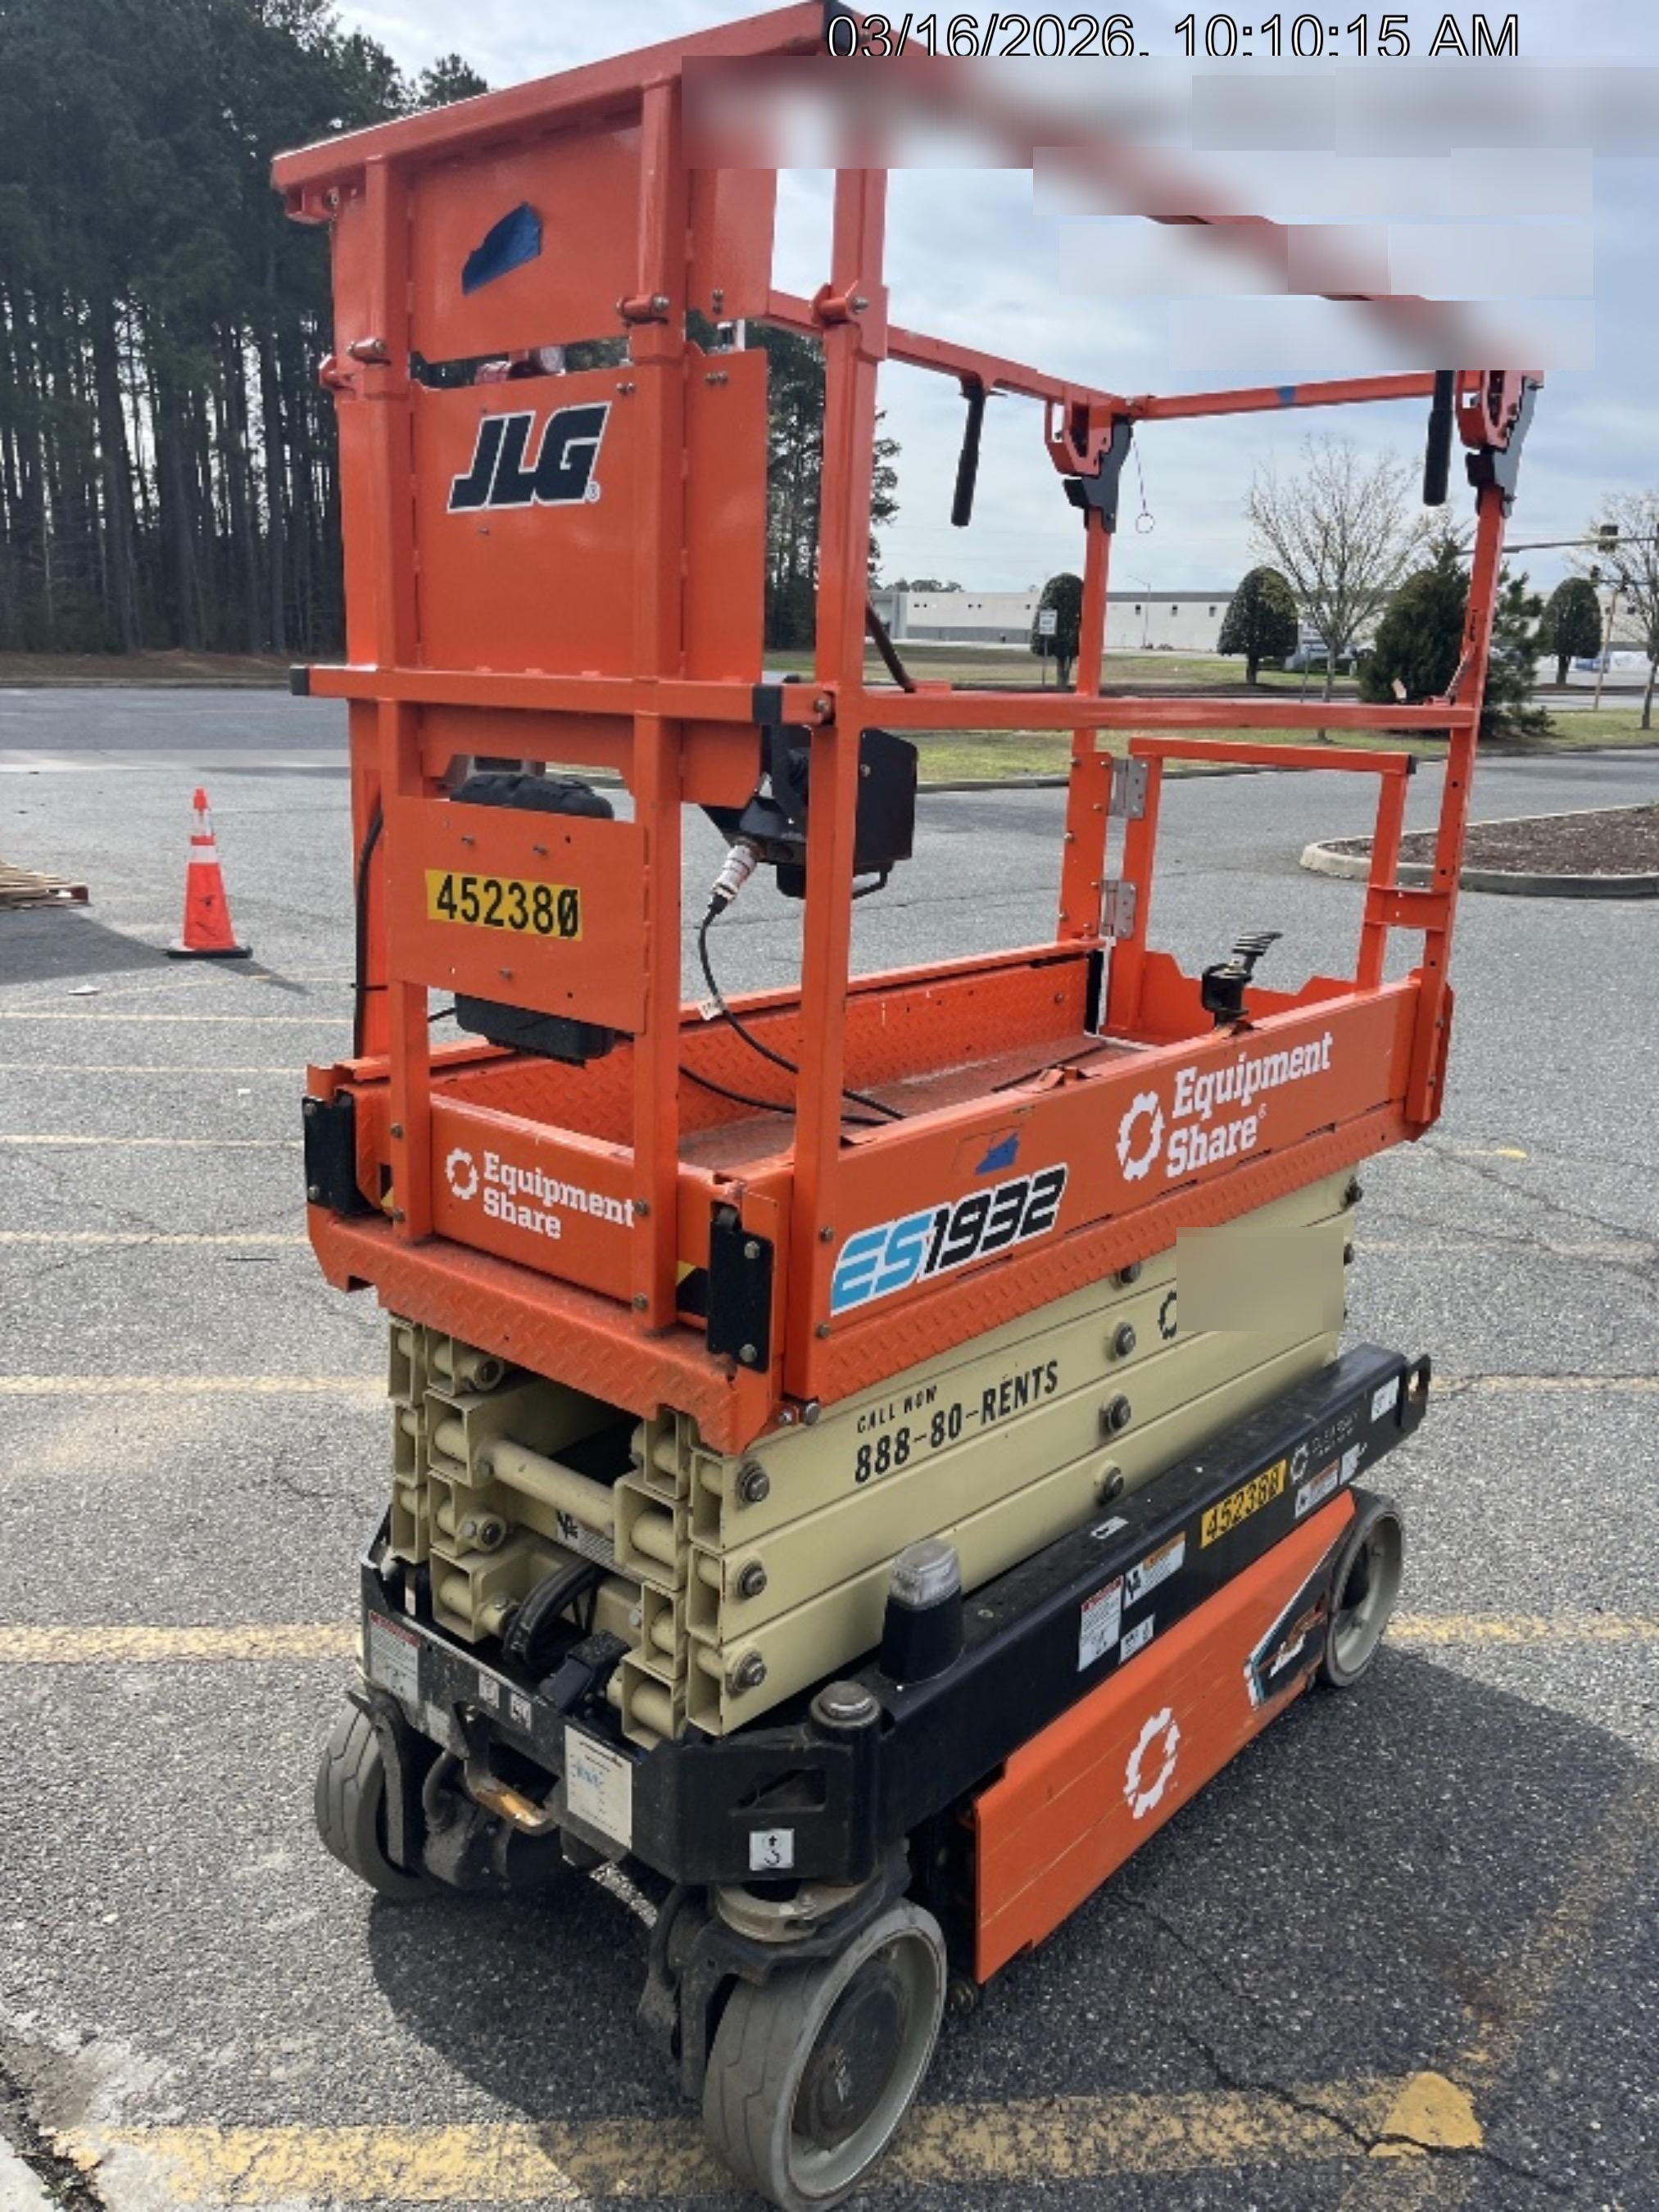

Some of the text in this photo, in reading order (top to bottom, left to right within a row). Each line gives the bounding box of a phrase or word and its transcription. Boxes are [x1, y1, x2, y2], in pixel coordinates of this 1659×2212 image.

[446, 400, 613, 514] JLG
[437, 873, 578, 937] 452380
[1172, 1031, 1334, 1121] Equipment
[483, 1149, 635, 1229] Equipment
[483, 1187, 562, 1240] Share
[830, 1162, 1069, 1317] ES1932
[854, 1359, 1058, 1484] 888-80-RENTS
[857, 1385, 938, 1434] CALL NOW
